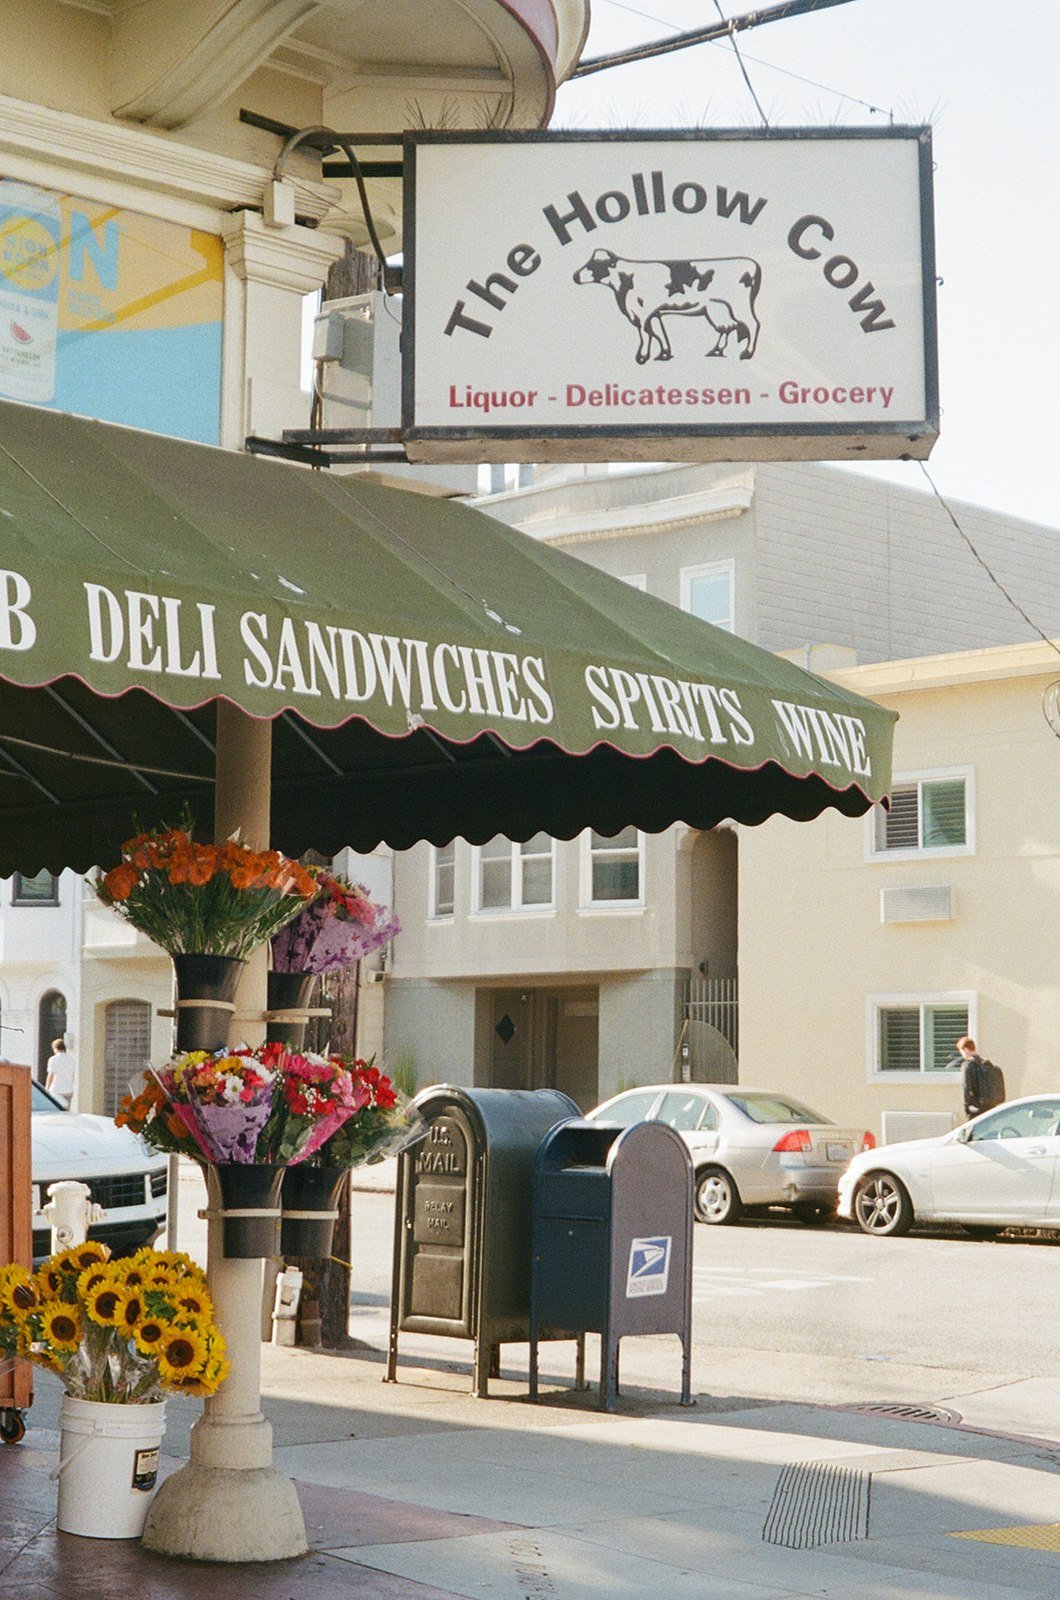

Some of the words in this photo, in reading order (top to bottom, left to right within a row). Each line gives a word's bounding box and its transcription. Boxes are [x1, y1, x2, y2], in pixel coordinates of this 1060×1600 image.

[444, 245, 541, 338] The
[543, 171, 768, 246] Hollow
[787, 214, 896, 333] Cow
[449, 384, 538, 413] Liquor
[565, 383, 751, 407] Delicatessen
[779, 380, 894, 408] Grocery
[83, 582, 222, 679] DELI
[240, 611, 554, 724] SANDWICHES
[585, 665, 755, 745] SPIRITS
[771, 699, 872, 777] WINE
[419, 1152, 460, 1173] MAIL
